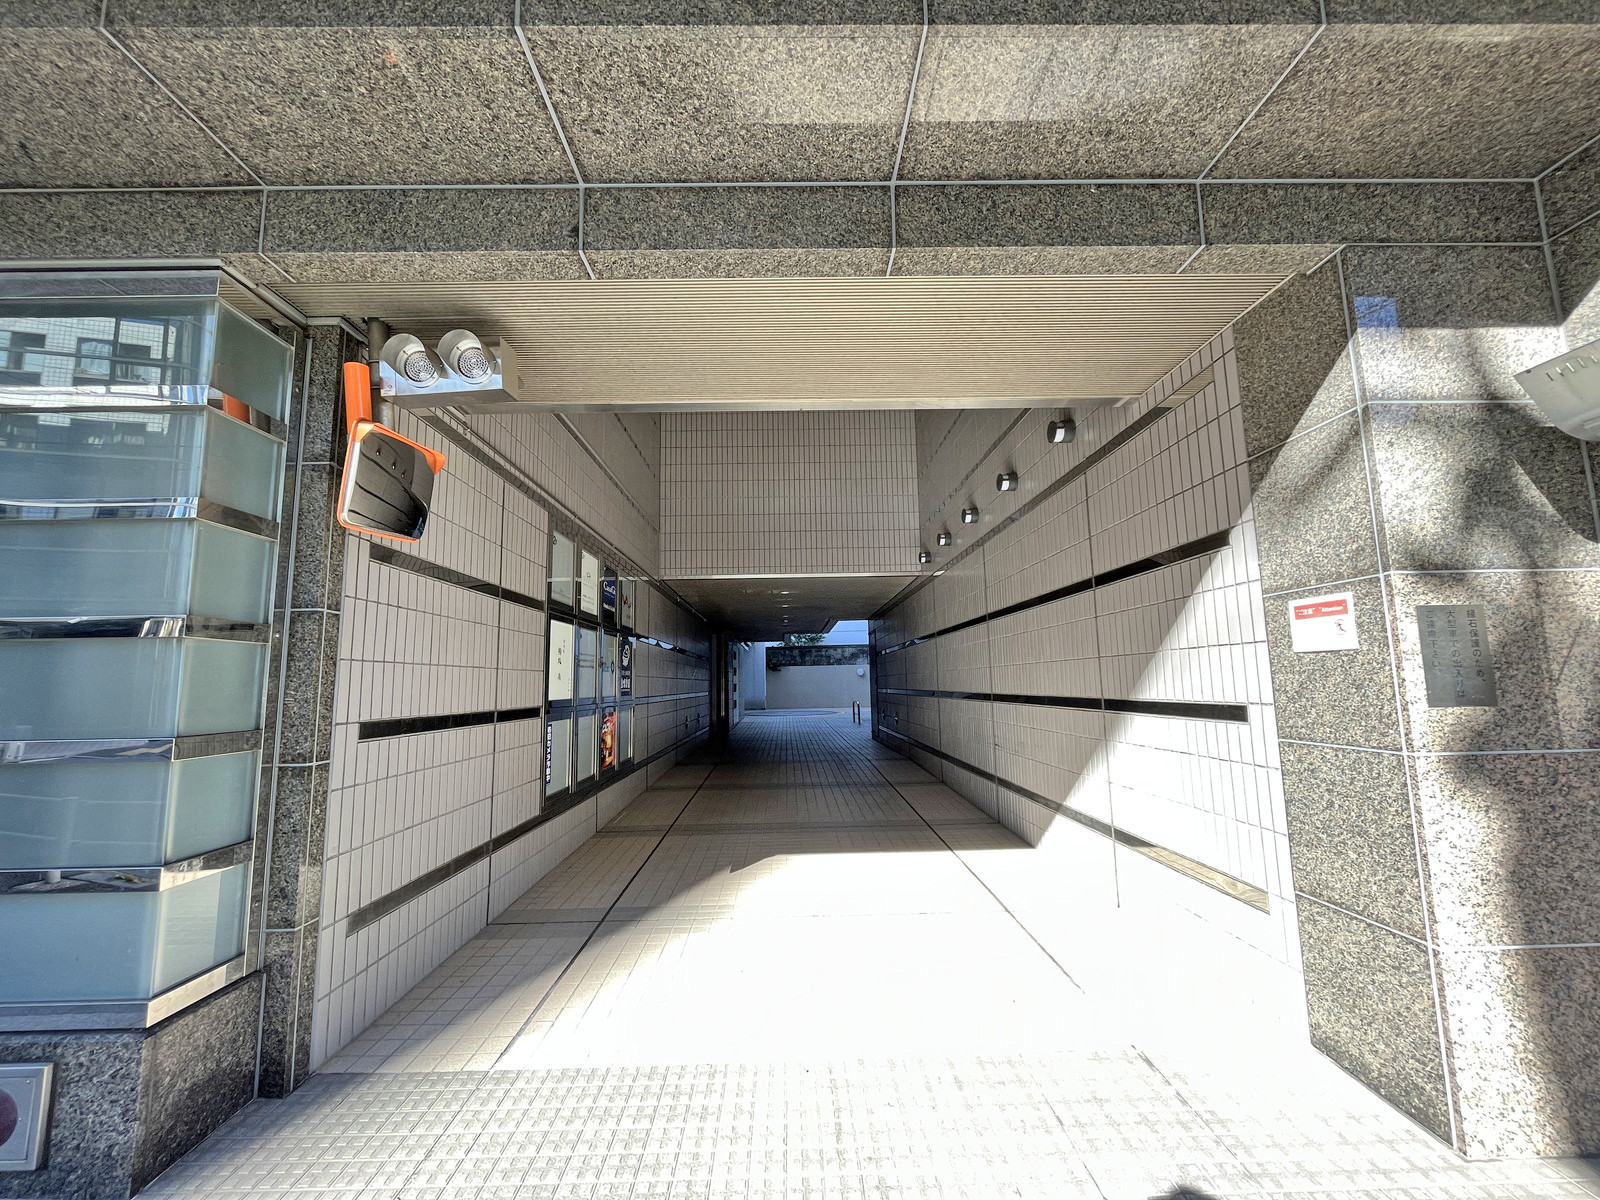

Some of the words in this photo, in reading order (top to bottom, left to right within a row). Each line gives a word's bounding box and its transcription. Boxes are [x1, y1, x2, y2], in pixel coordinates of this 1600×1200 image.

[1446, 609, 1466, 698] 大型車での出入りは
